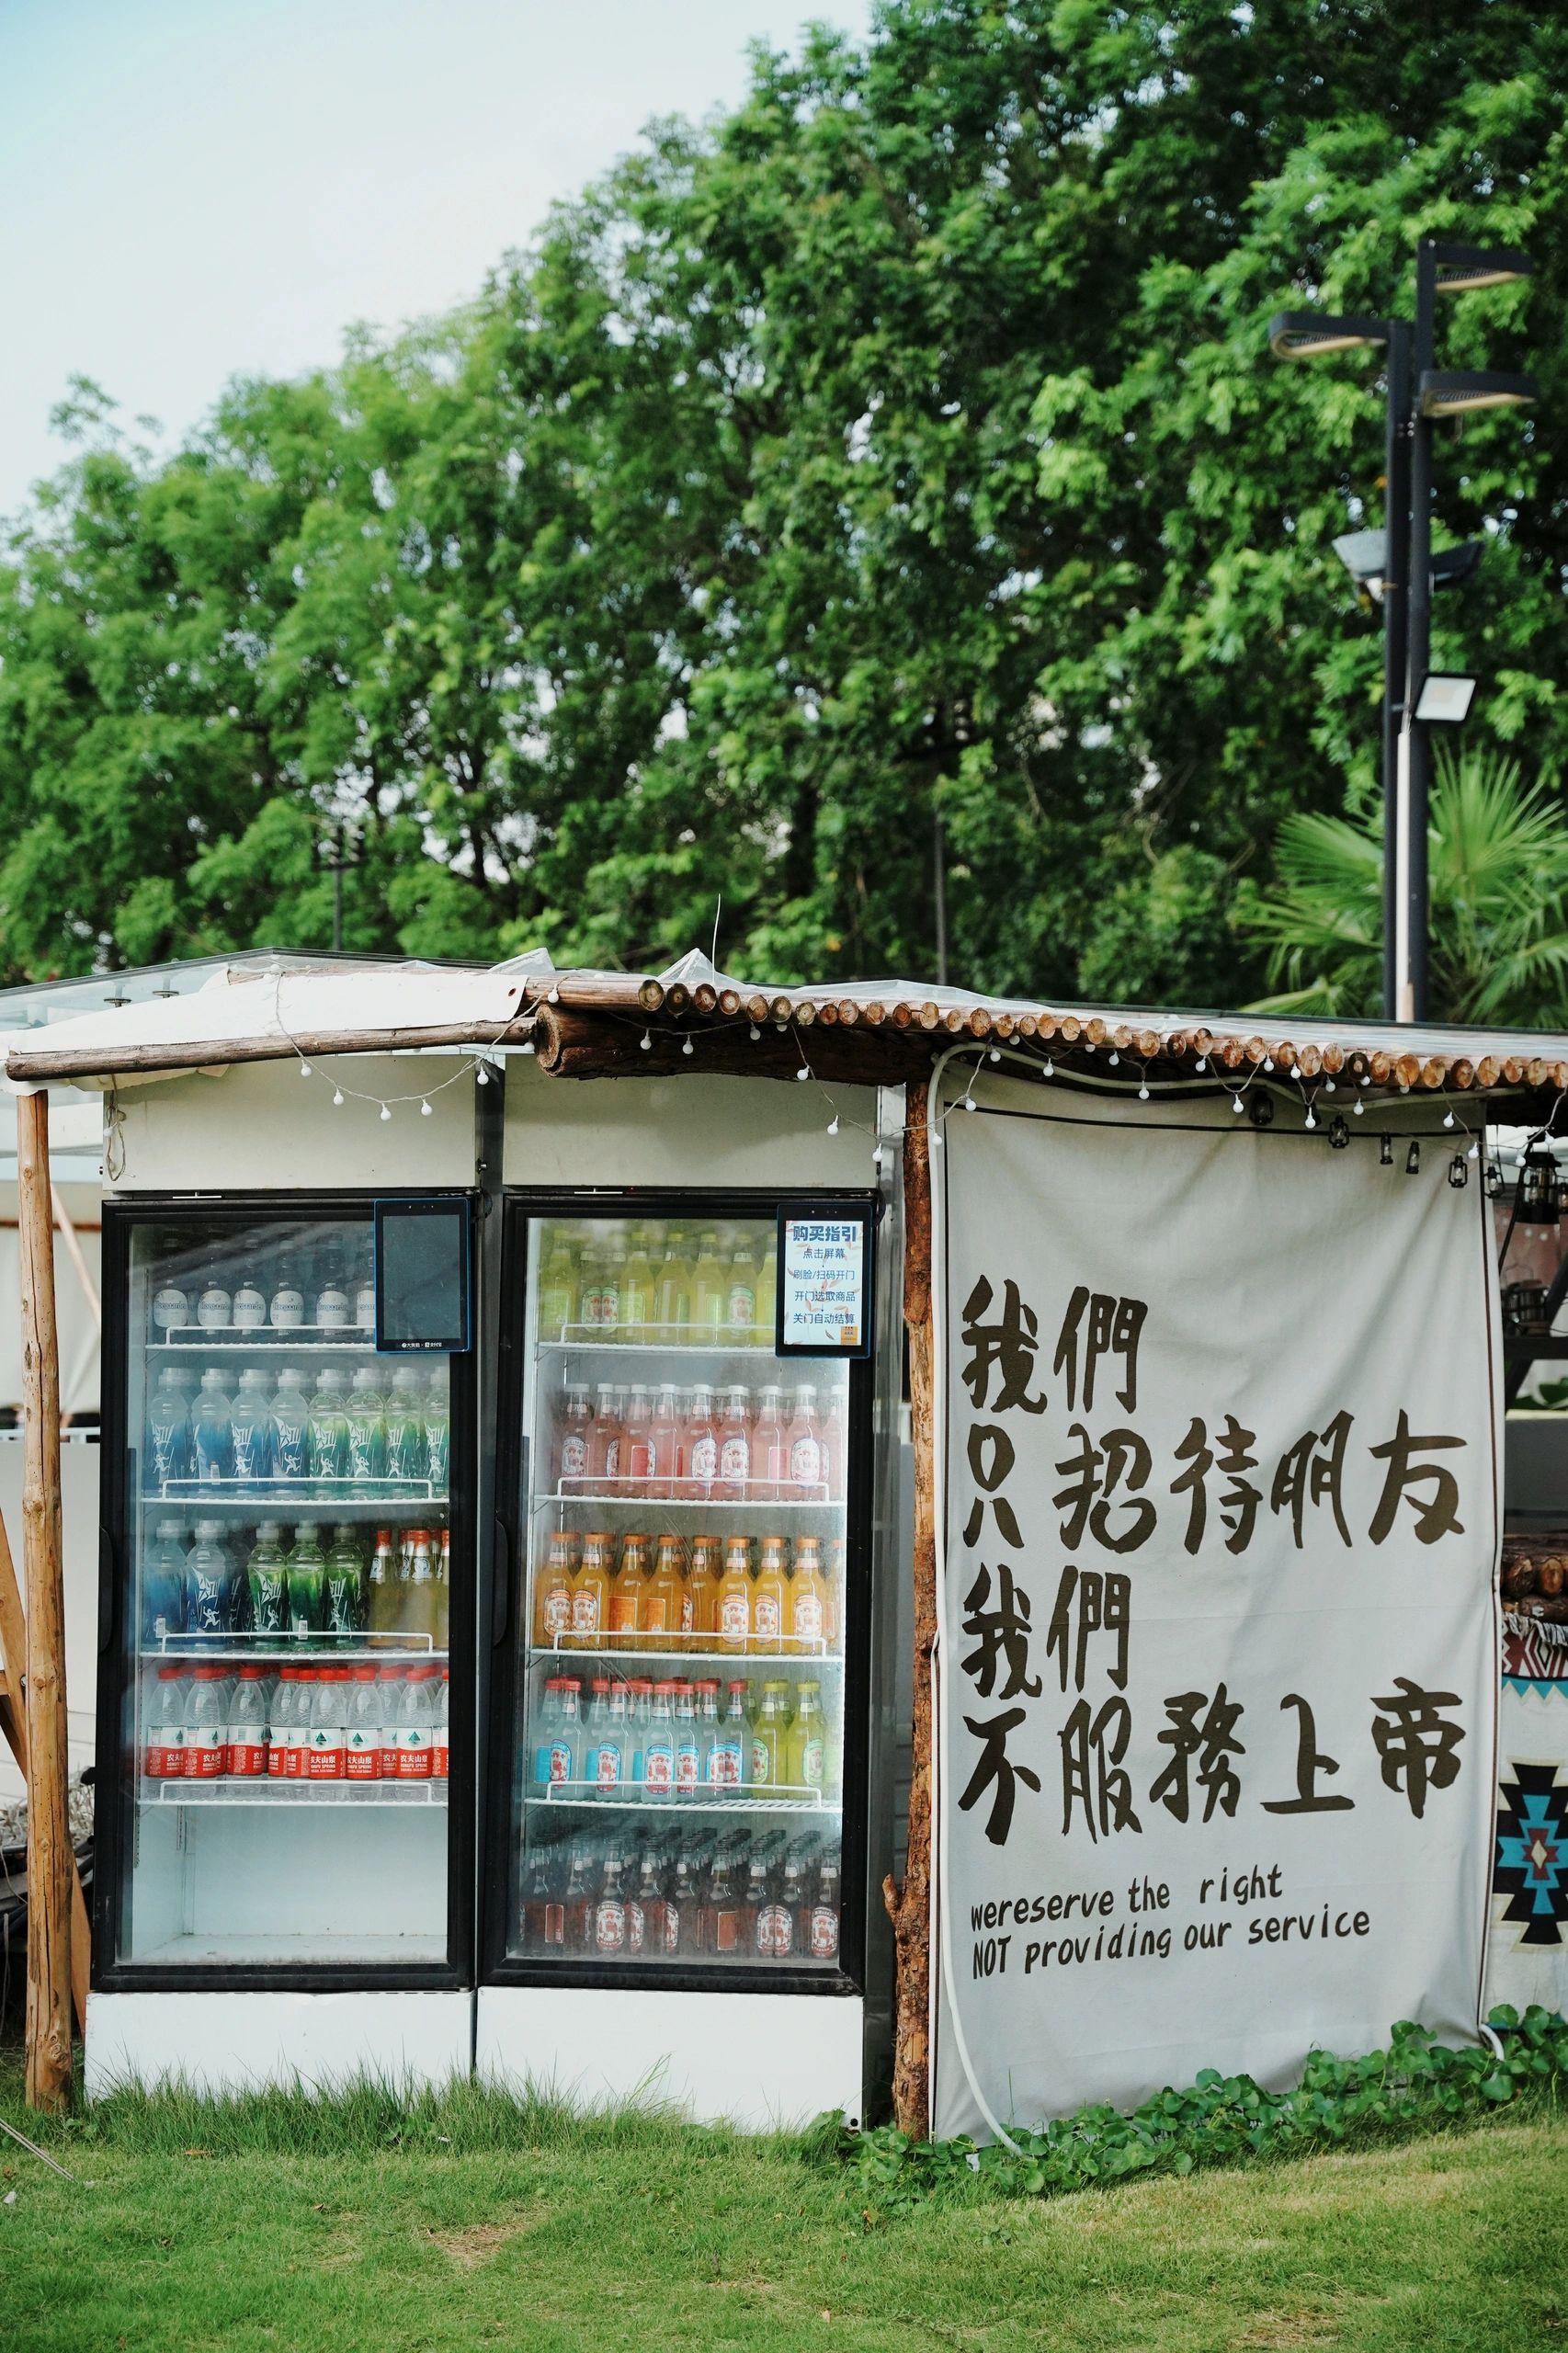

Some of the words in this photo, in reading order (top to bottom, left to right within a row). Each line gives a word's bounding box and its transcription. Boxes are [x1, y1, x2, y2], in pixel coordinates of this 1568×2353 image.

[793, 1225, 857, 1242] 购买指引
[802, 1247, 846, 1259] 点击屏幕
[793, 1269, 855, 1280] 刷脸/扫码开门
[794, 1290, 856, 1302] 开门选取商品
[793, 1313, 855, 1324] 关门自动结算
[960, 1274, 1149, 1415] 我們
[962, 1409, 1468, 1556] 只招待朋友
[960, 1562, 1131, 1700] 我們
[957, 1677, 1466, 1847] 不服務上帝
[1128, 1874, 1171, 1914] the
[1199, 1863, 1283, 1906] right
[972, 1934, 1012, 1980] NOT
[1024, 1922, 1172, 1974] providing
[1184, 1922, 1233, 1951] our
[1248, 1903, 1369, 1945] service
